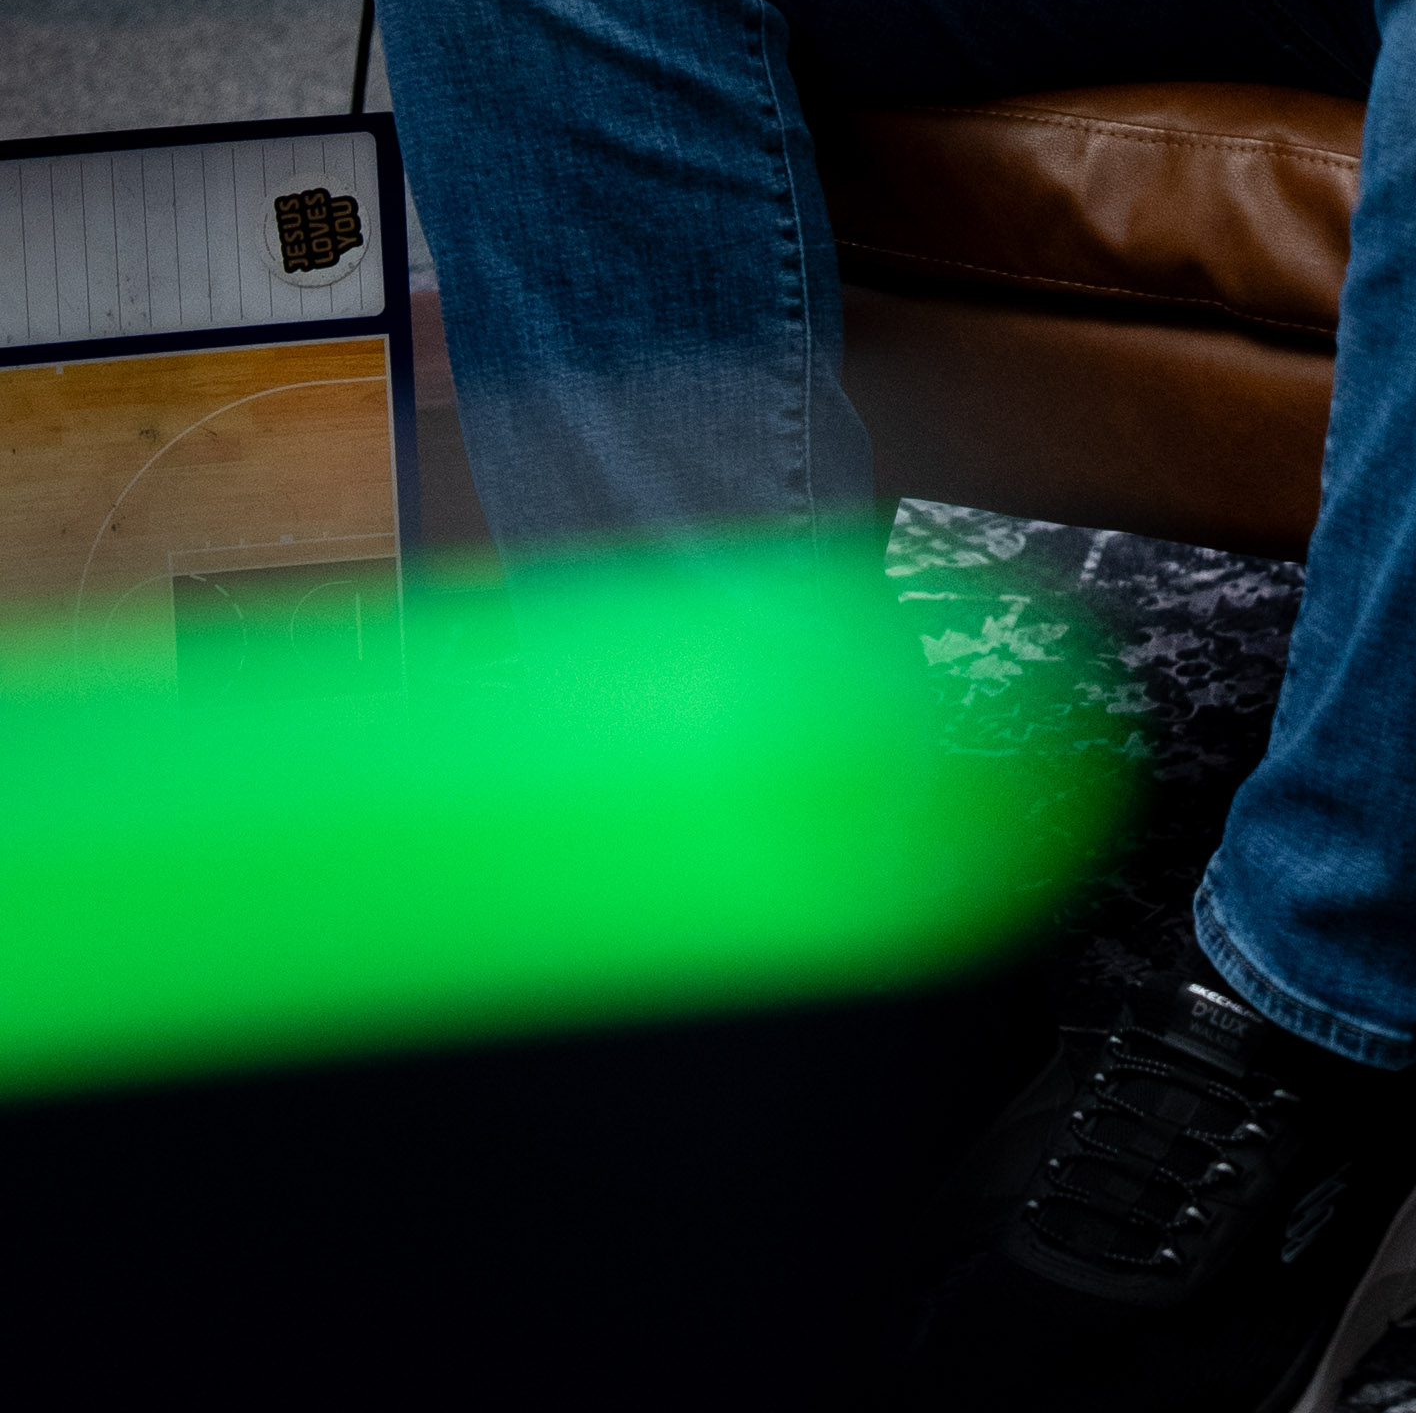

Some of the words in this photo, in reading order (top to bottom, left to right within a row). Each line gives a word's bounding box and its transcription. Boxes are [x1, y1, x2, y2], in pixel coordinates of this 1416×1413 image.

[279, 197, 309, 268] JESUS
[304, 192, 335, 265] LOVES
[331, 200, 357, 250] YOU
[1192, 999, 1249, 1040] D'LUX
